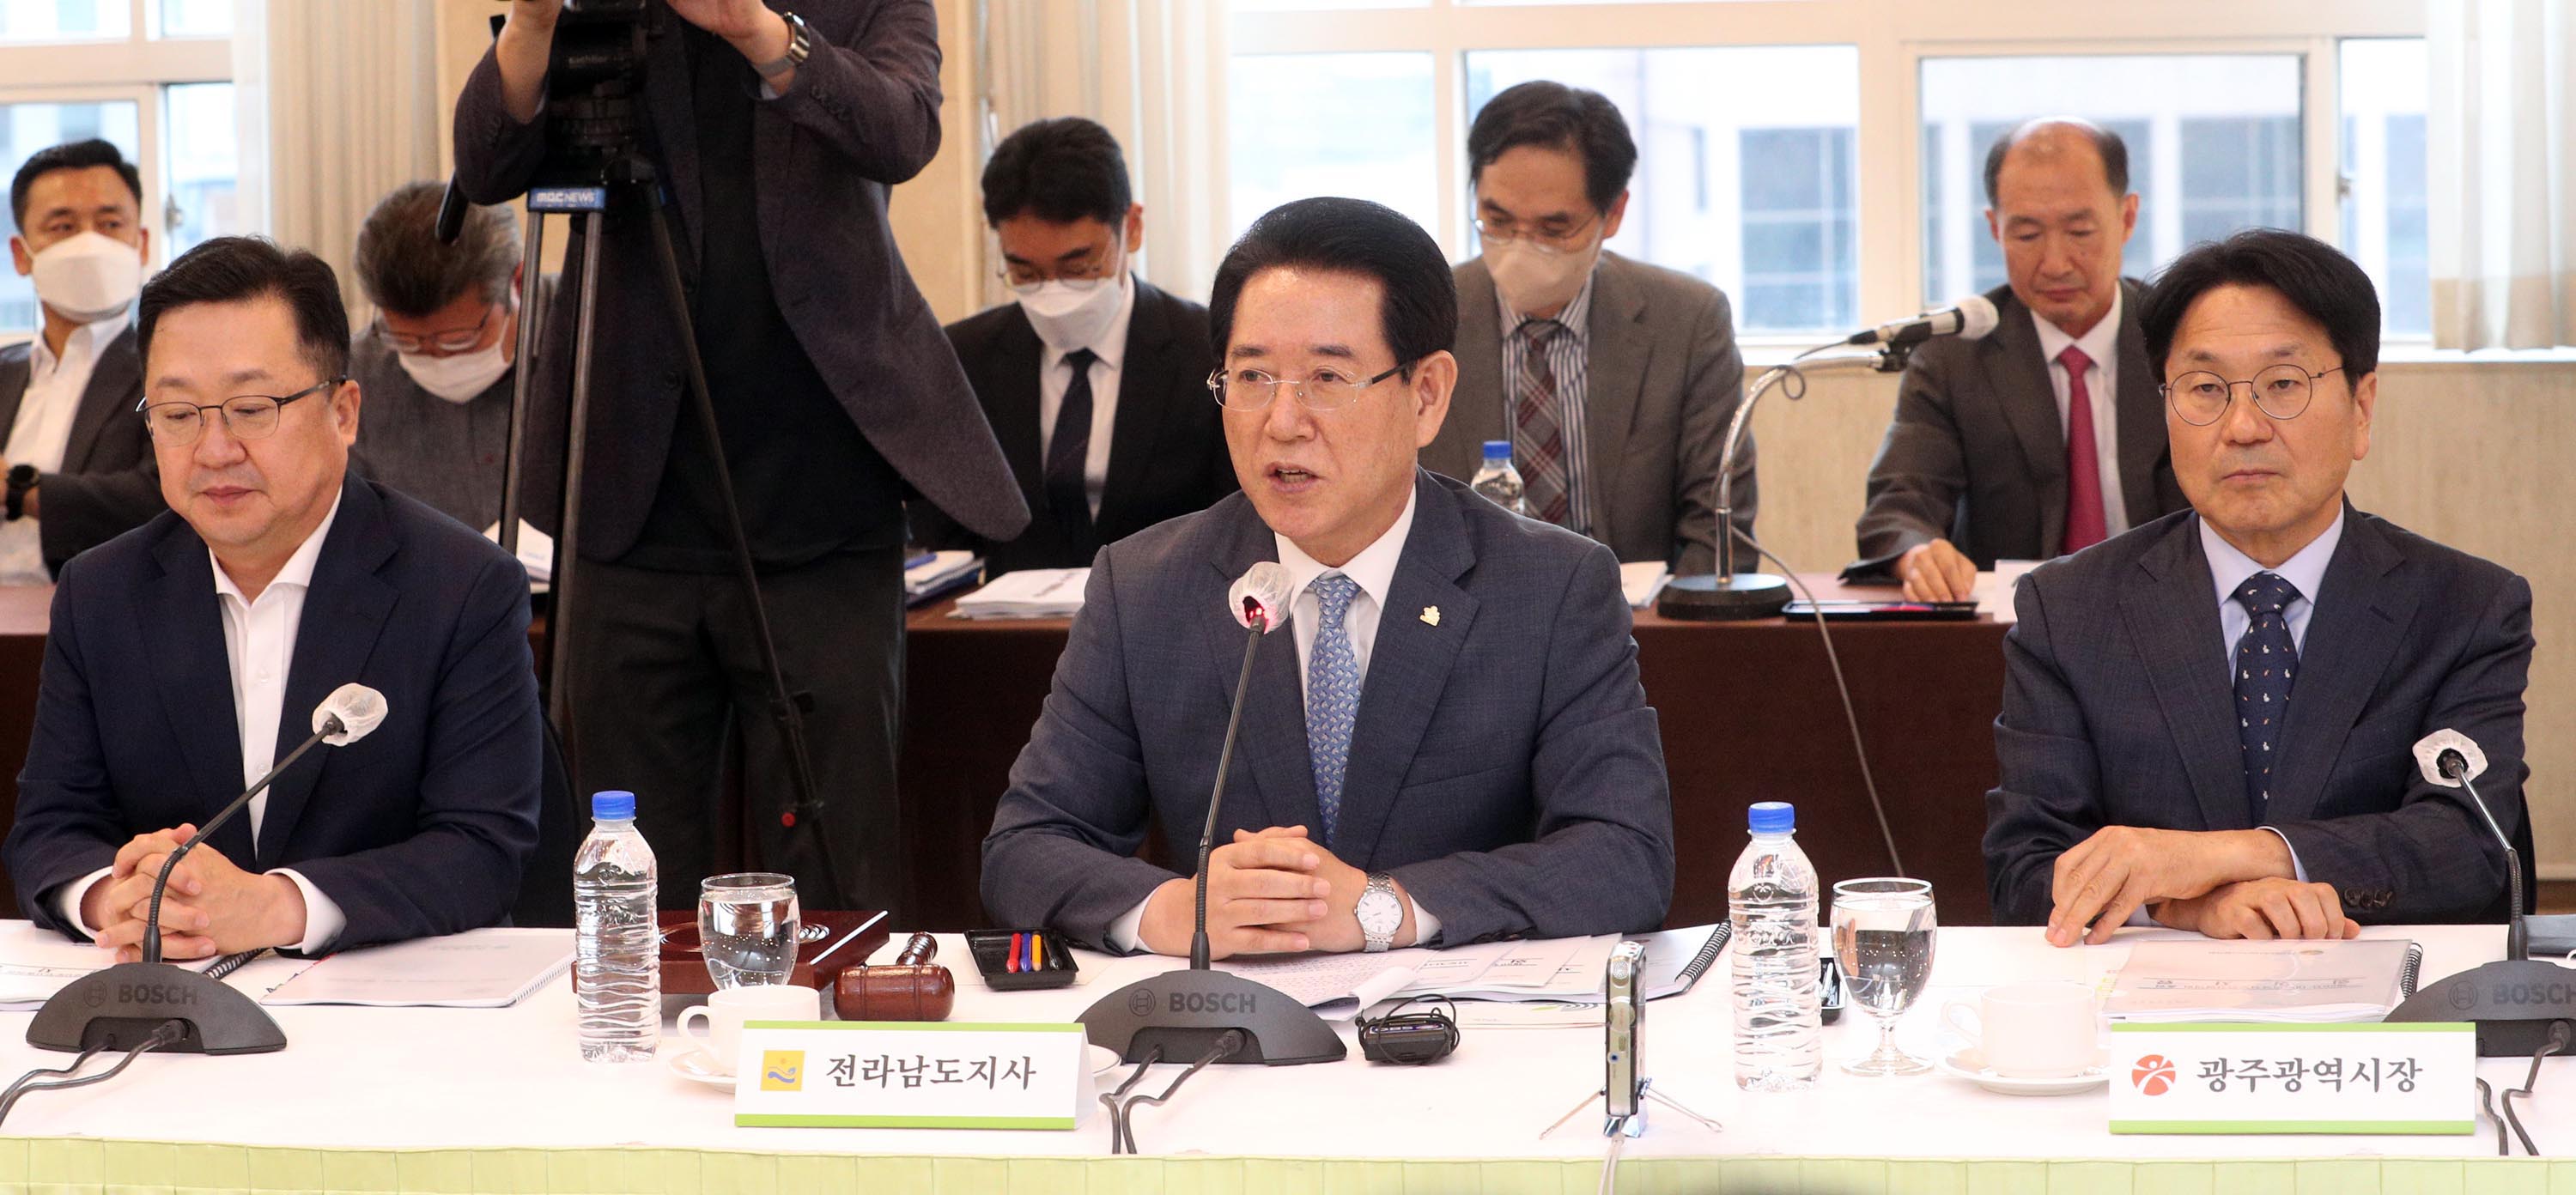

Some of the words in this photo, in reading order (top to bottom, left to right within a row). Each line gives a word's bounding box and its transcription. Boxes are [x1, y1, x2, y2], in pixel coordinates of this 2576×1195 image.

[565, 191, 595, 203] NEWS
[118, 984, 197, 1005] BOSCH
[1169, 992, 1256, 1013] BOSCH
[826, 1054, 1037, 1090] 전라남도지사
[2196, 1057, 2423, 1093] 광주광역시장
